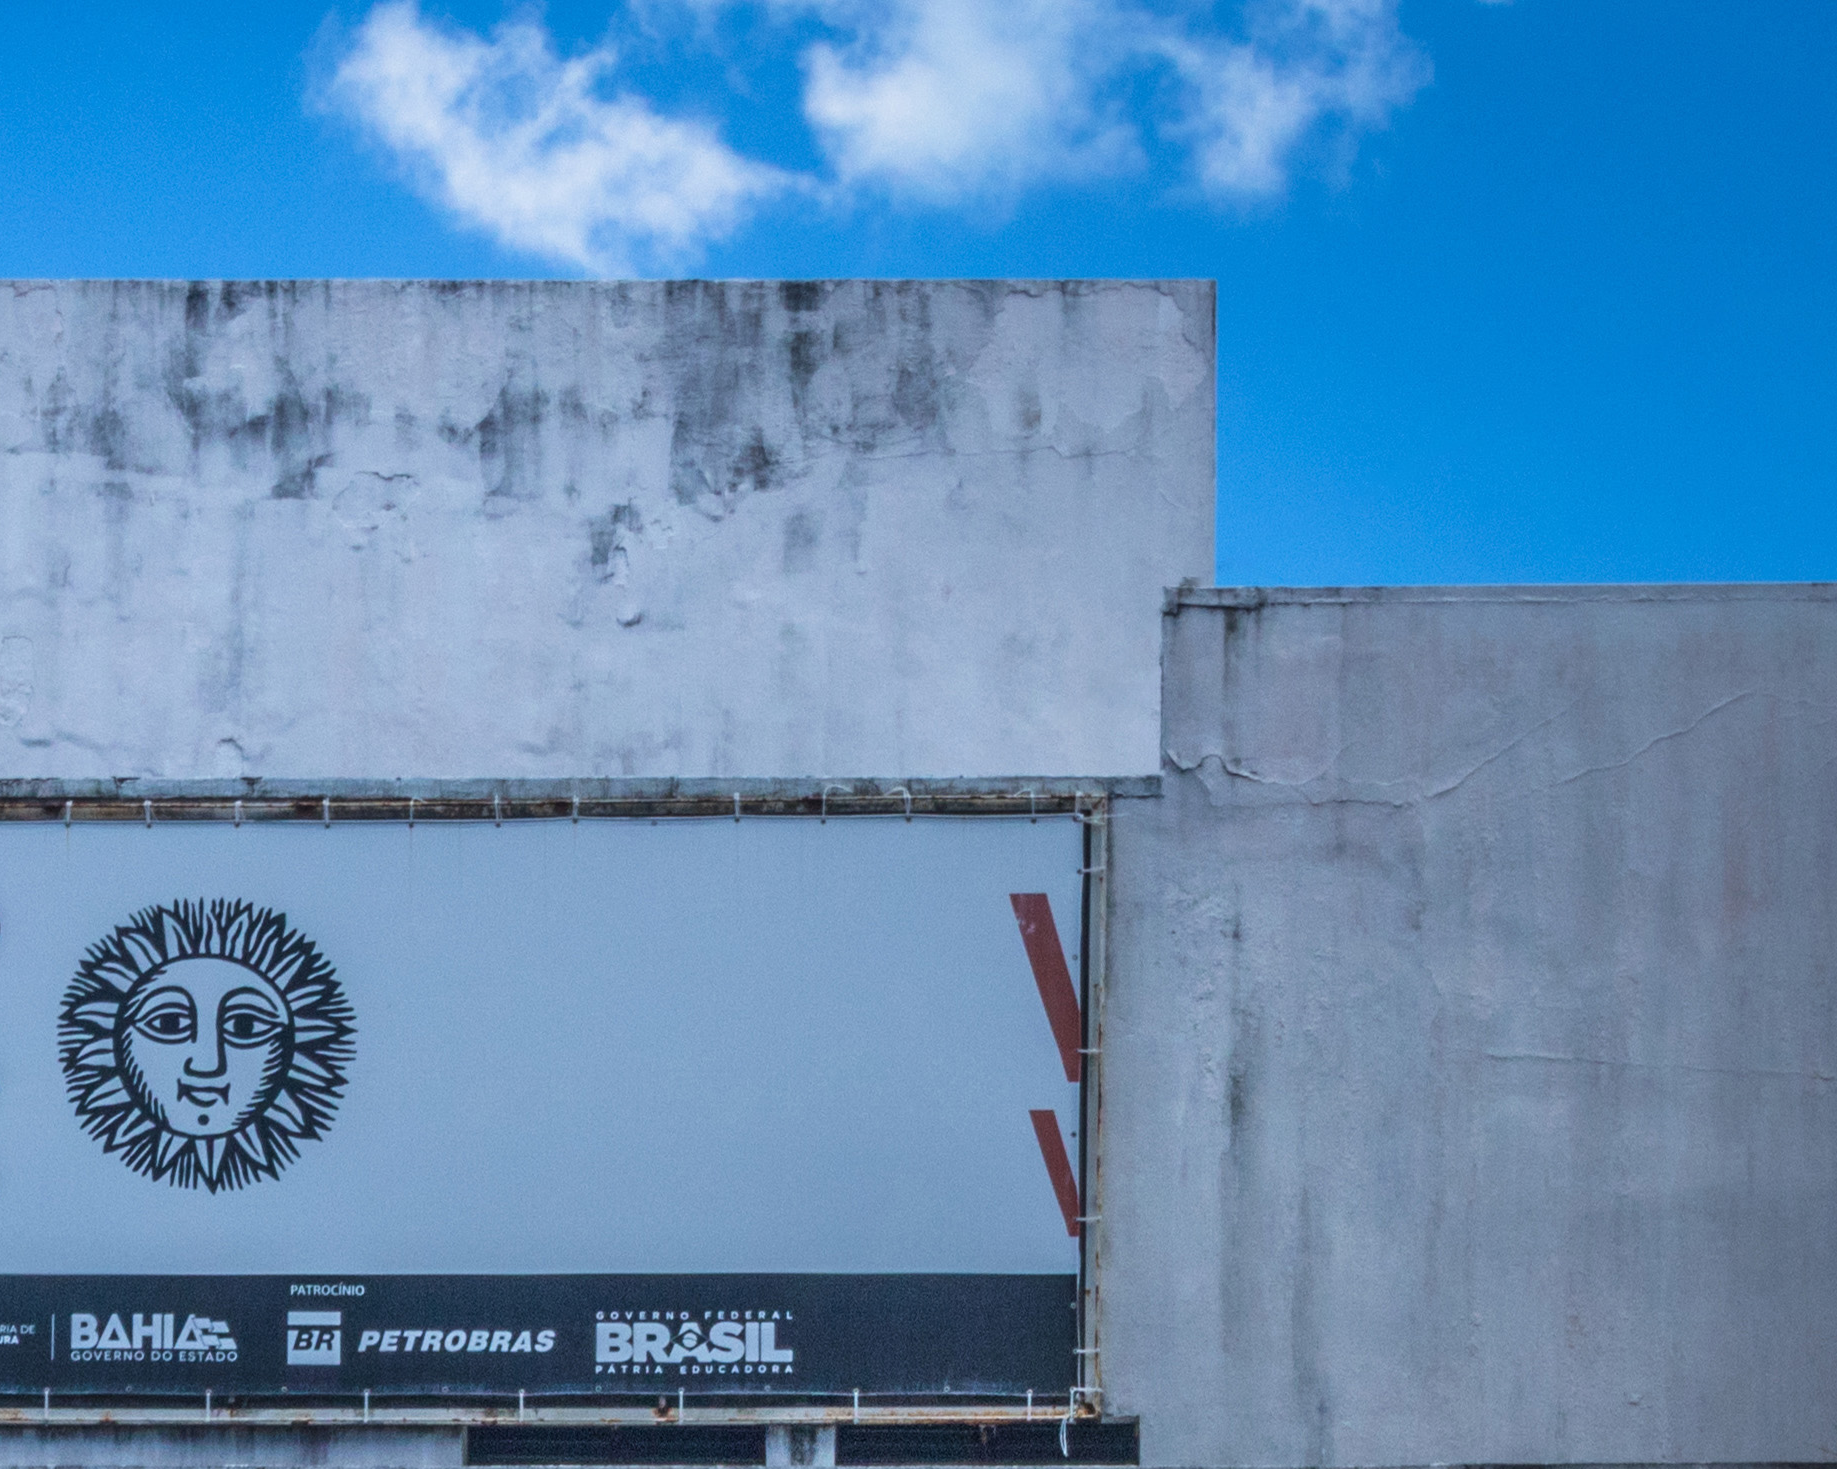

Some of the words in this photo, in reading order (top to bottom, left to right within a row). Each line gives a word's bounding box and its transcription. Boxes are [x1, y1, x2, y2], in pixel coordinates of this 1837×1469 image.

[290, 1281, 365, 1297] PATROCÍNIO
[596, 1311, 690, 1321] GOVERNO
[704, 1311, 794, 1321] FEDERAL
[20, 1324, 36, 1334] DE
[70, 1313, 210, 1350] BAHIA
[293, 1332, 335, 1351] BR
[357, 1330, 556, 1352] PETROBRAS
[595, 1321, 794, 1363] BRASIL
[70, 1350, 146, 1362] GOVERNO
[150, 1350, 173, 1362] DO
[179, 1350, 238, 1362] ESTADO
[679, 1365, 794, 1375] EDUCADORA
